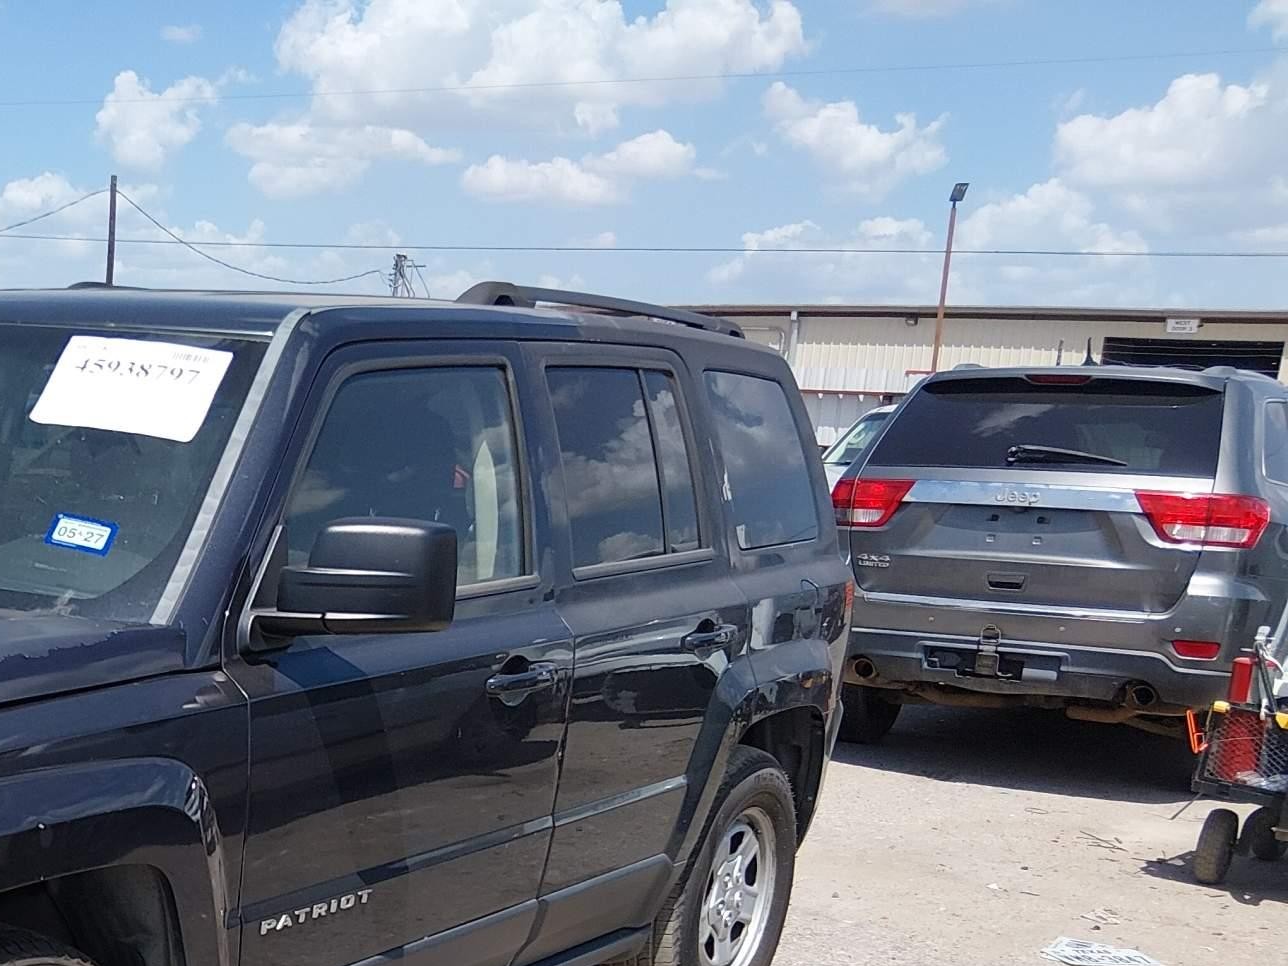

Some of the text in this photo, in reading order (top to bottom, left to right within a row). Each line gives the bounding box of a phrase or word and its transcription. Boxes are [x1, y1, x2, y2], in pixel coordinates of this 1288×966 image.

[75, 358, 201, 384] 45938797
[994, 488, 1040, 506] Jeep
[260, 889, 373, 935] PATRIOT
